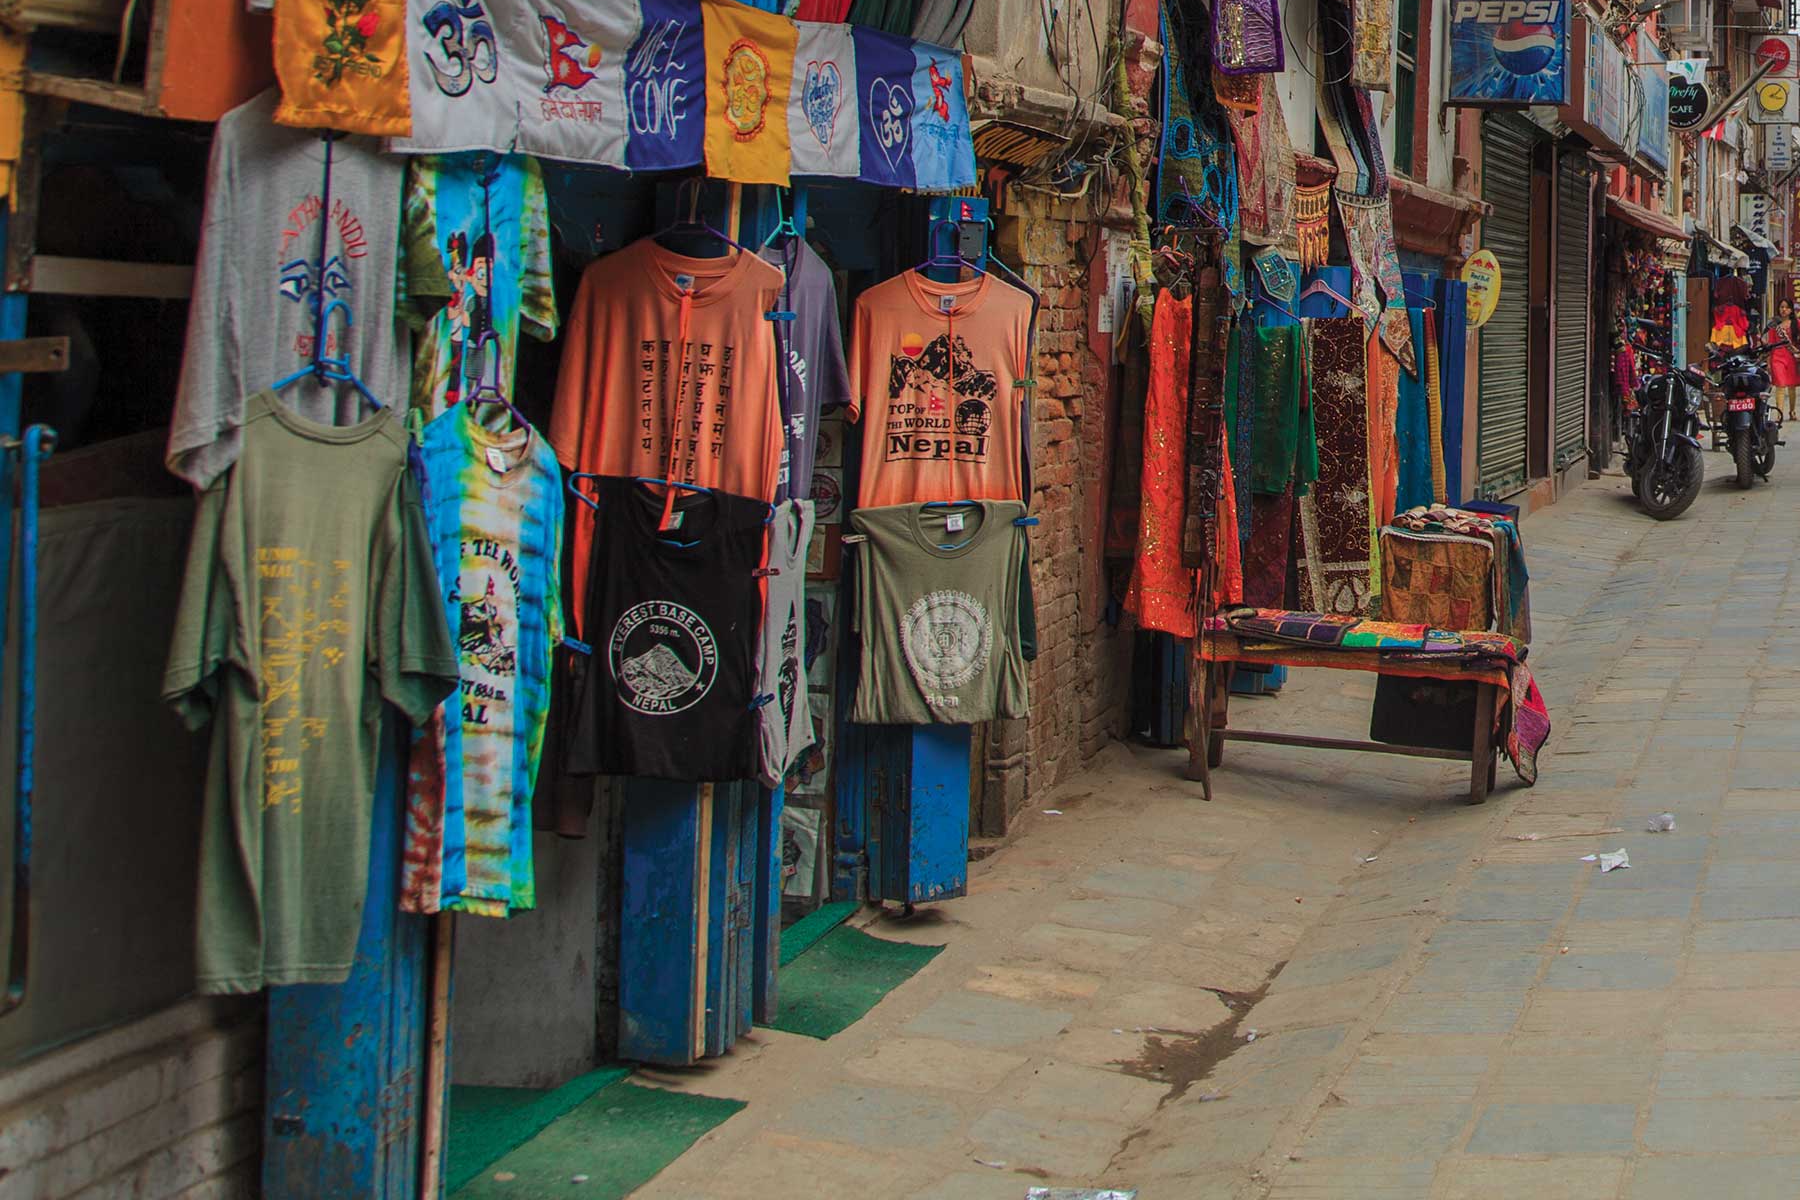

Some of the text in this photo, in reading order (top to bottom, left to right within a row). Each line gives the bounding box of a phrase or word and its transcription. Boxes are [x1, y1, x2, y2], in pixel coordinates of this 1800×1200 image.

[1453, 0, 1561, 25] PEPSI
[1669, 105, 1694, 114] CAFE
[888, 403, 916, 415] TOP
[903, 417, 951, 429] WORLD
[889, 434, 986, 459] Nepal
[612, 604, 715, 666] EVEREST BASE CAMP
[631, 694, 677, 712] NEPAL
